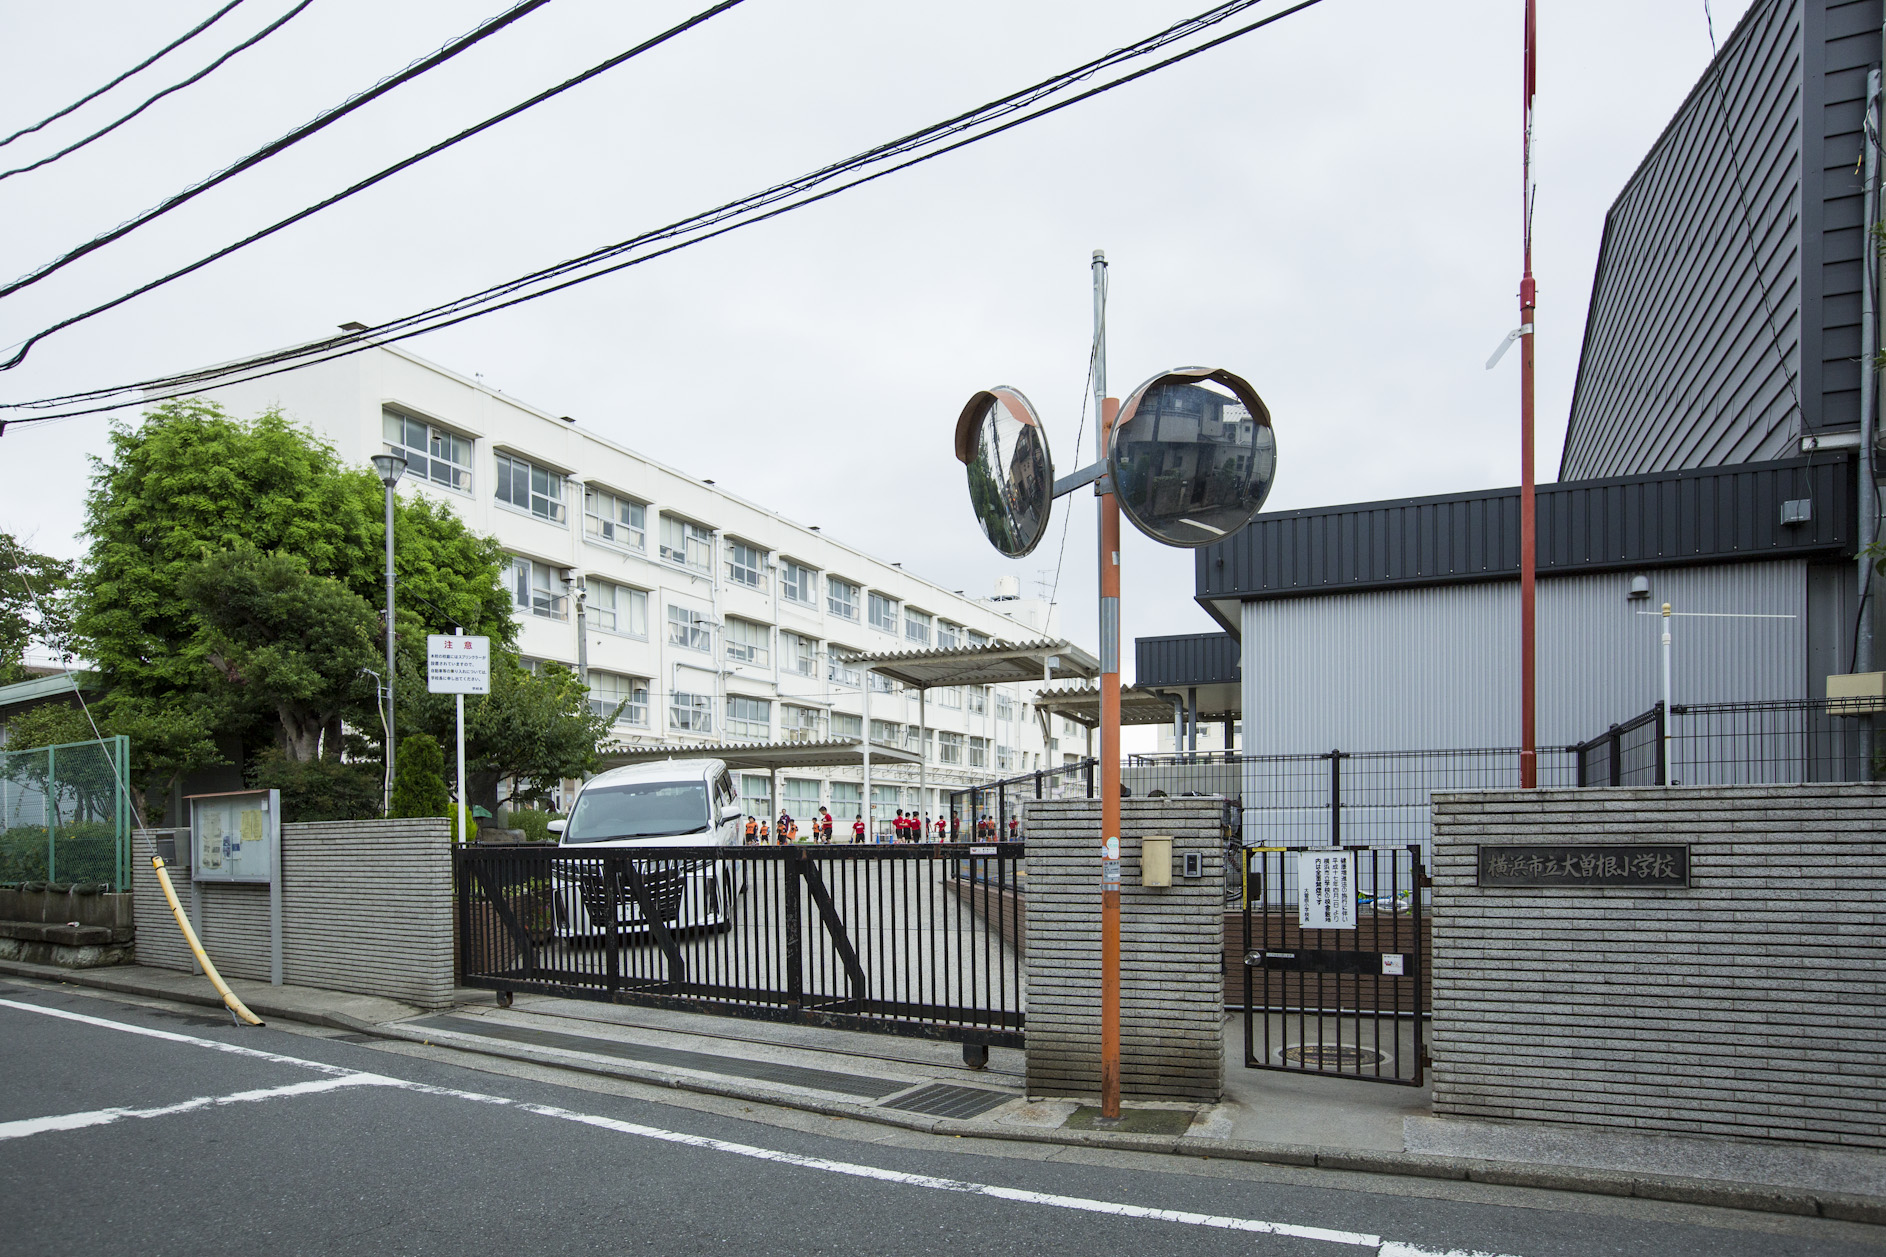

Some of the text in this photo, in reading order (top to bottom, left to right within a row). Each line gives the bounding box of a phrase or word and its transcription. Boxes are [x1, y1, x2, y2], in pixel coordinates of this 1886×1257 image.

[444, 640, 473, 650] 注意
[1488, 853, 1680, 879] 横浜市立大曽根小学校
